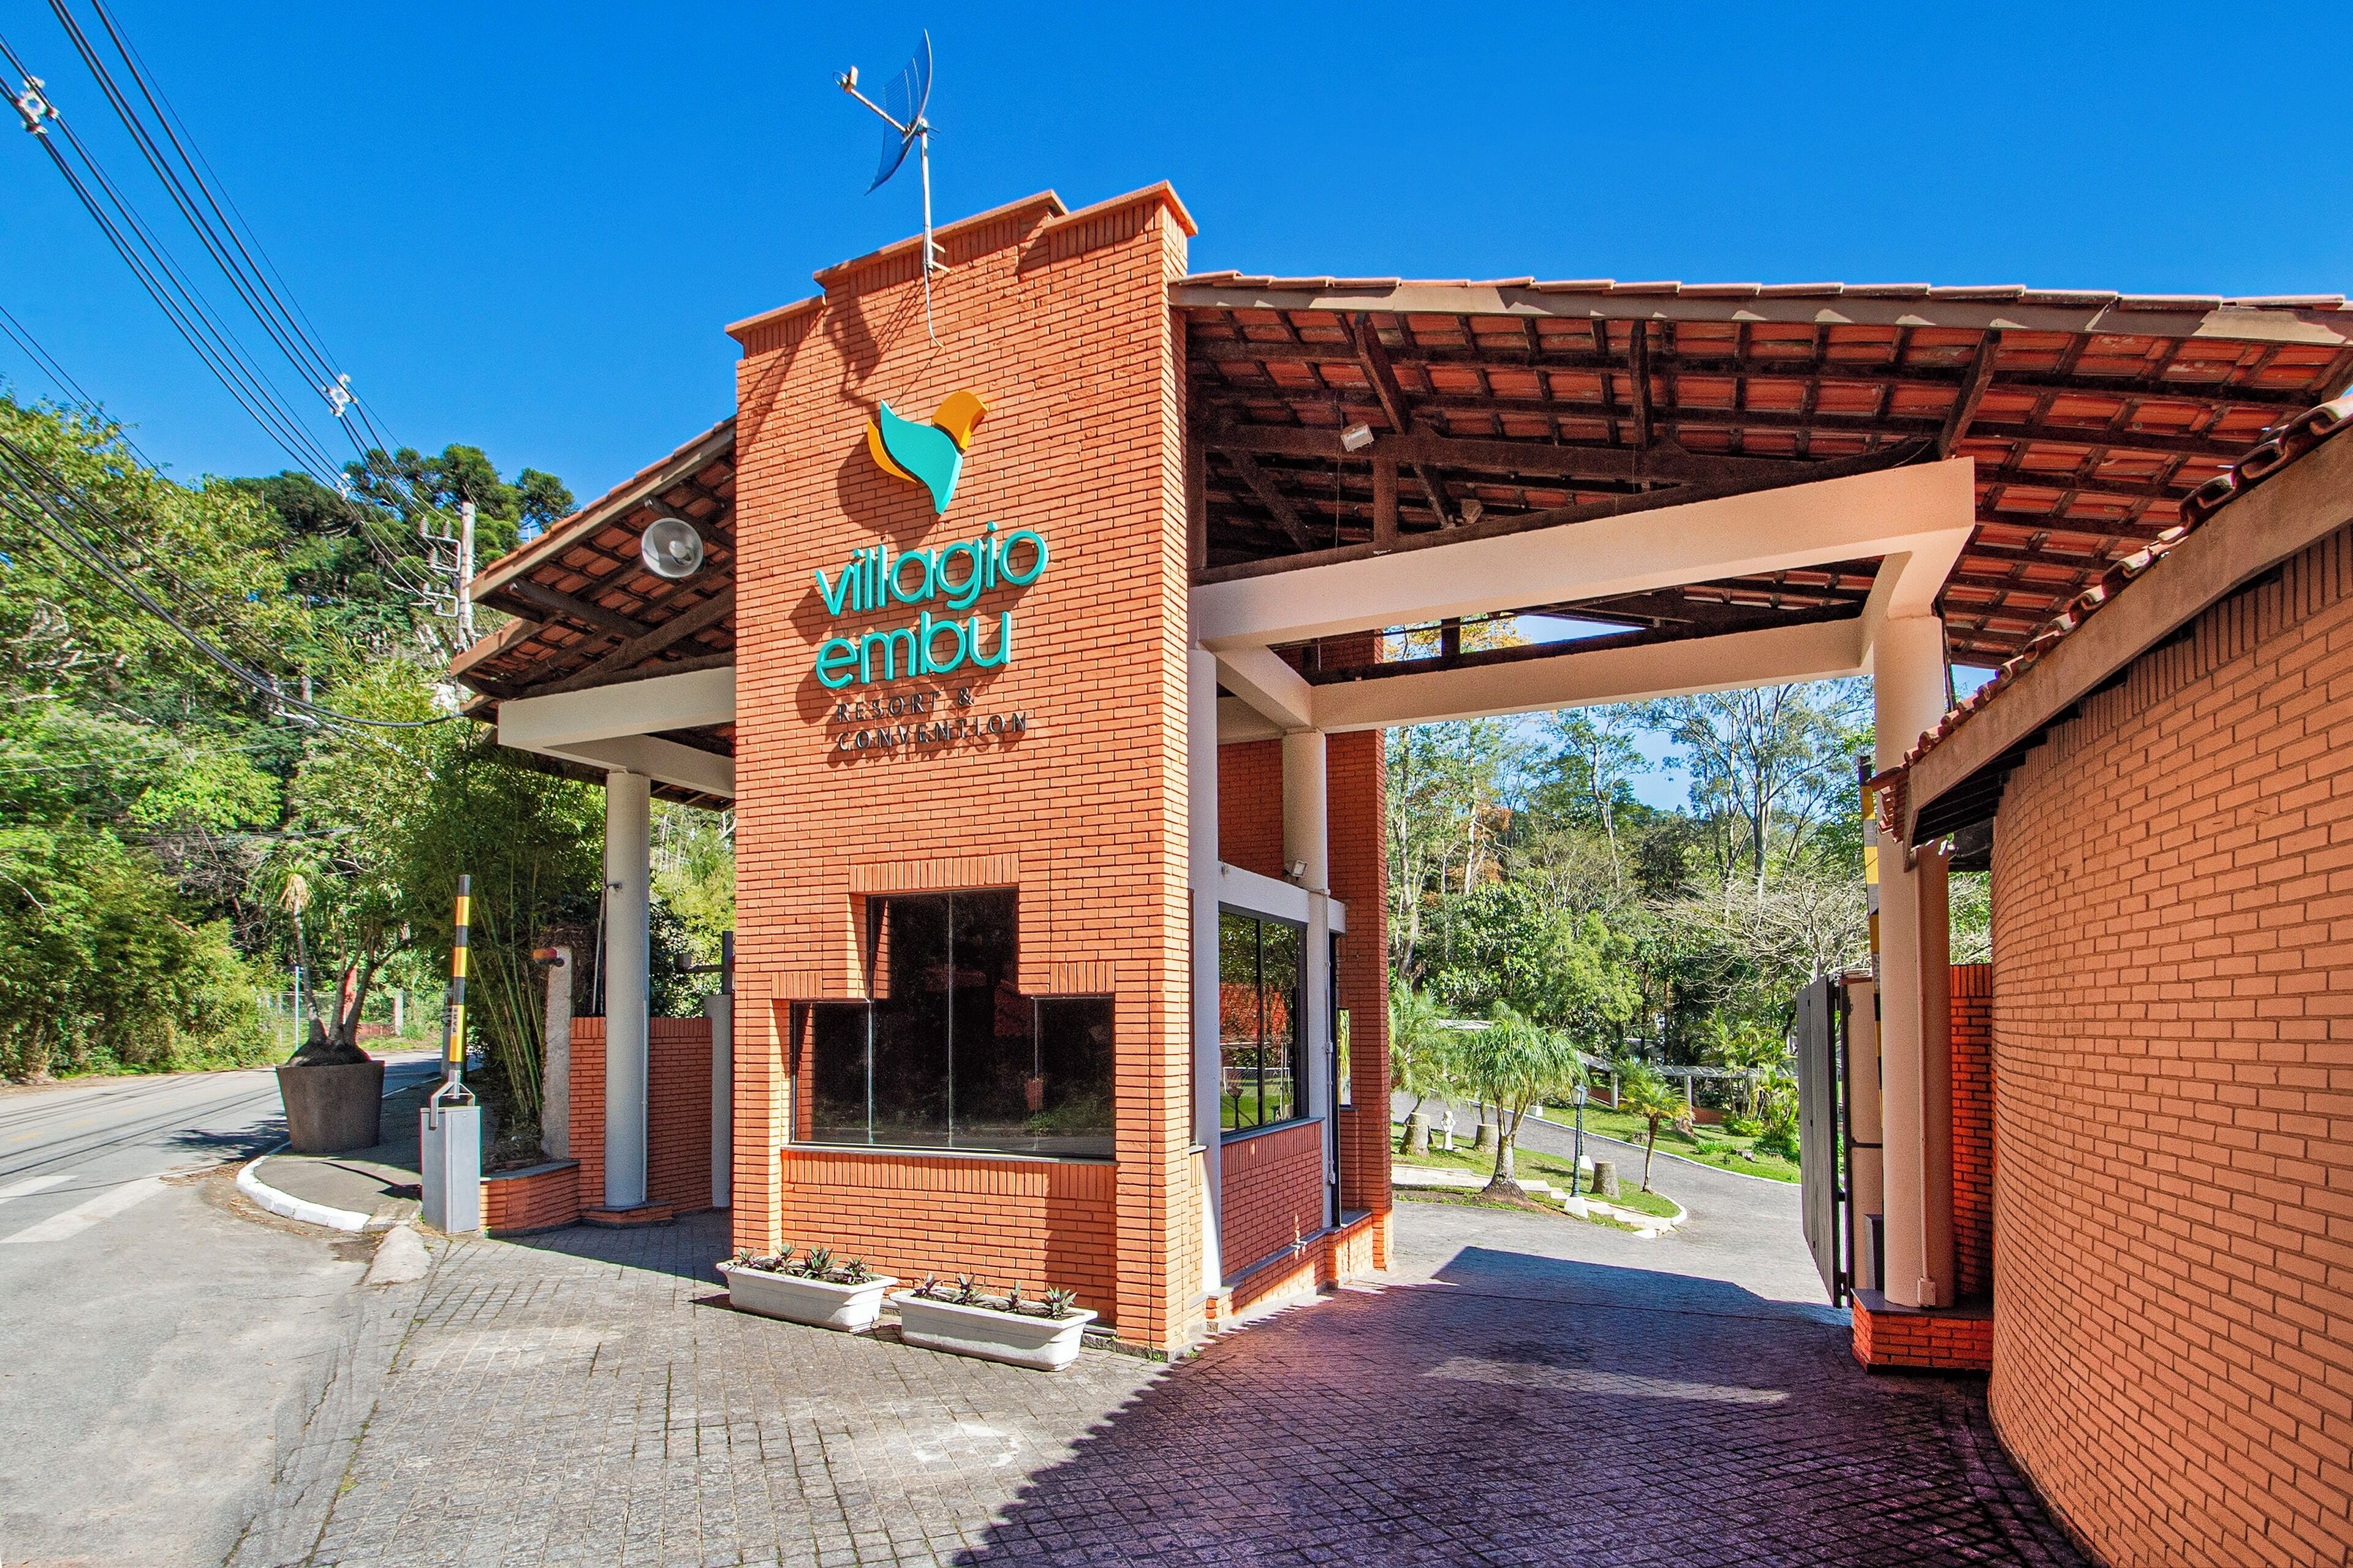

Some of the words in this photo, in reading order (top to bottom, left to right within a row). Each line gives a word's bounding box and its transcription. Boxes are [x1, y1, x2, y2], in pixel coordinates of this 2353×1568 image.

[815, 520, 1049, 616] villagio
[816, 611, 1012, 689] embu
[837, 691, 940, 723] RESORT
[958, 686, 975, 706] &
[838, 711, 1028, 751] CONVENTION
